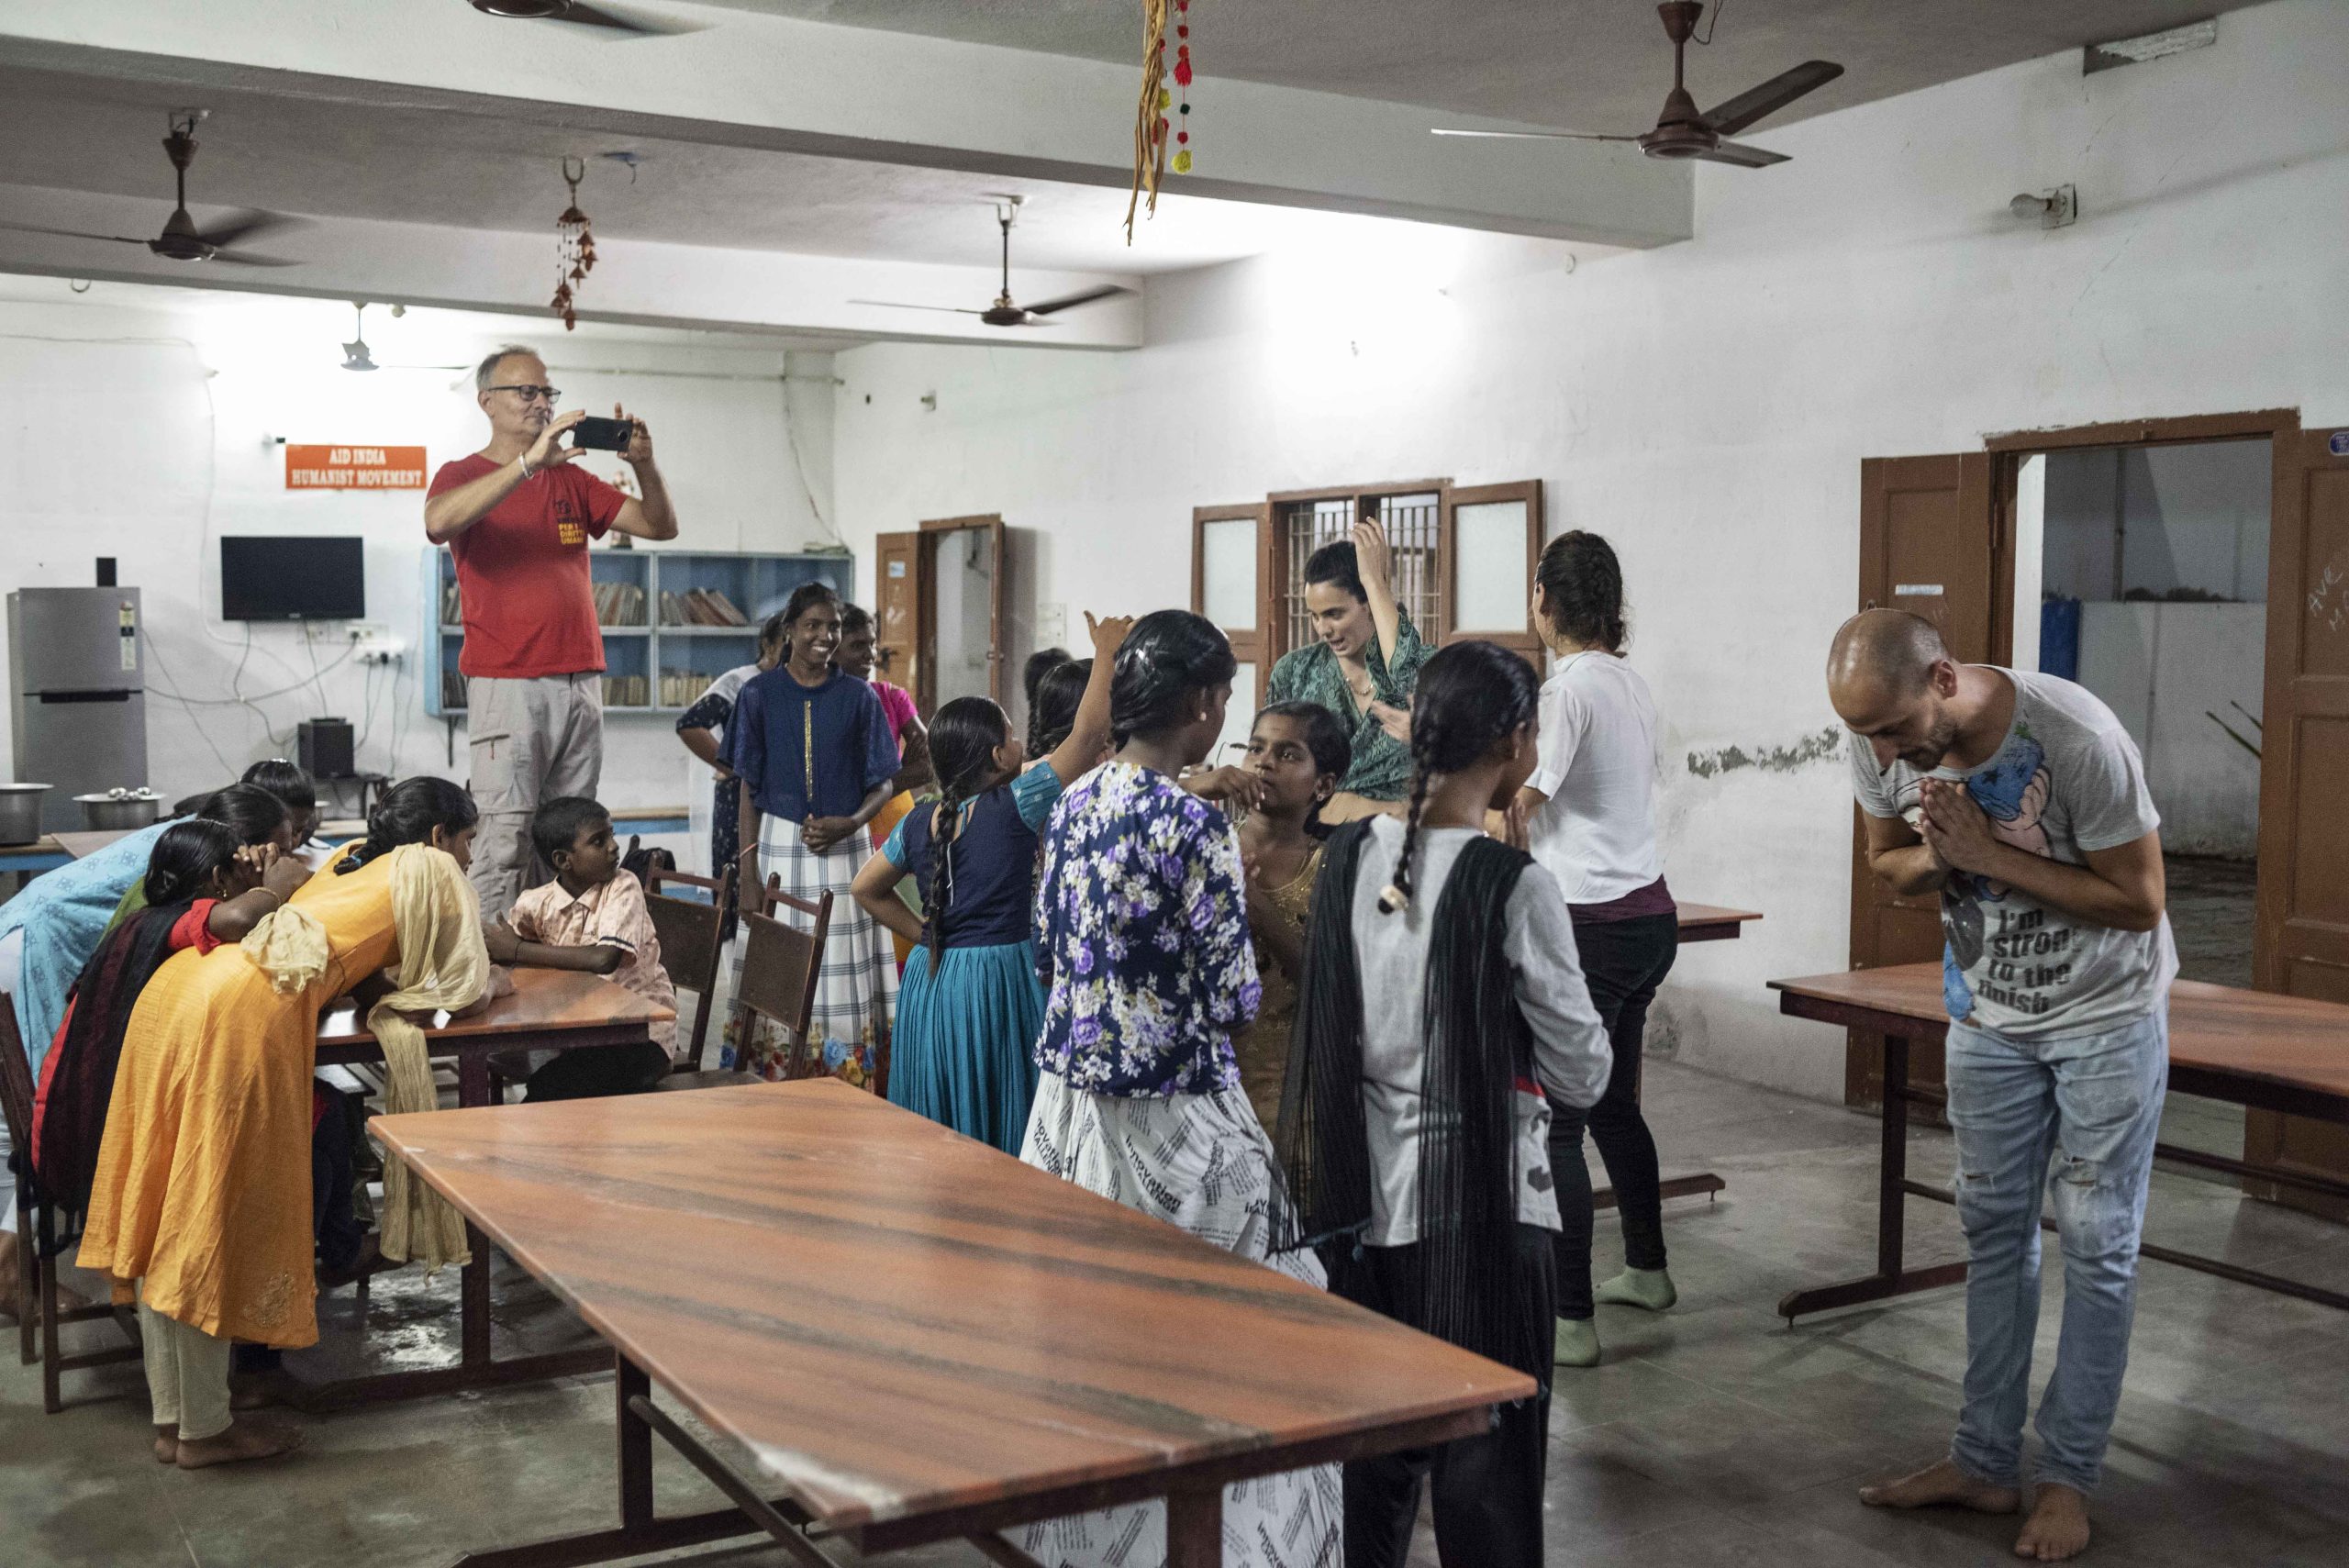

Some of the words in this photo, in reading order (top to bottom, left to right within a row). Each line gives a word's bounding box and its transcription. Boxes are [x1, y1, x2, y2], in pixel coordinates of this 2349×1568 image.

[328, 448, 351, 465] AID
[353, 448, 386, 465] INDIA
[292, 469, 355, 485] HUMANIST
[357, 469, 422, 486] MOVEMENT
[1998, 907, 2043, 933] I'm
[1988, 959, 2014, 982] to
[2023, 963, 2071, 988] the
